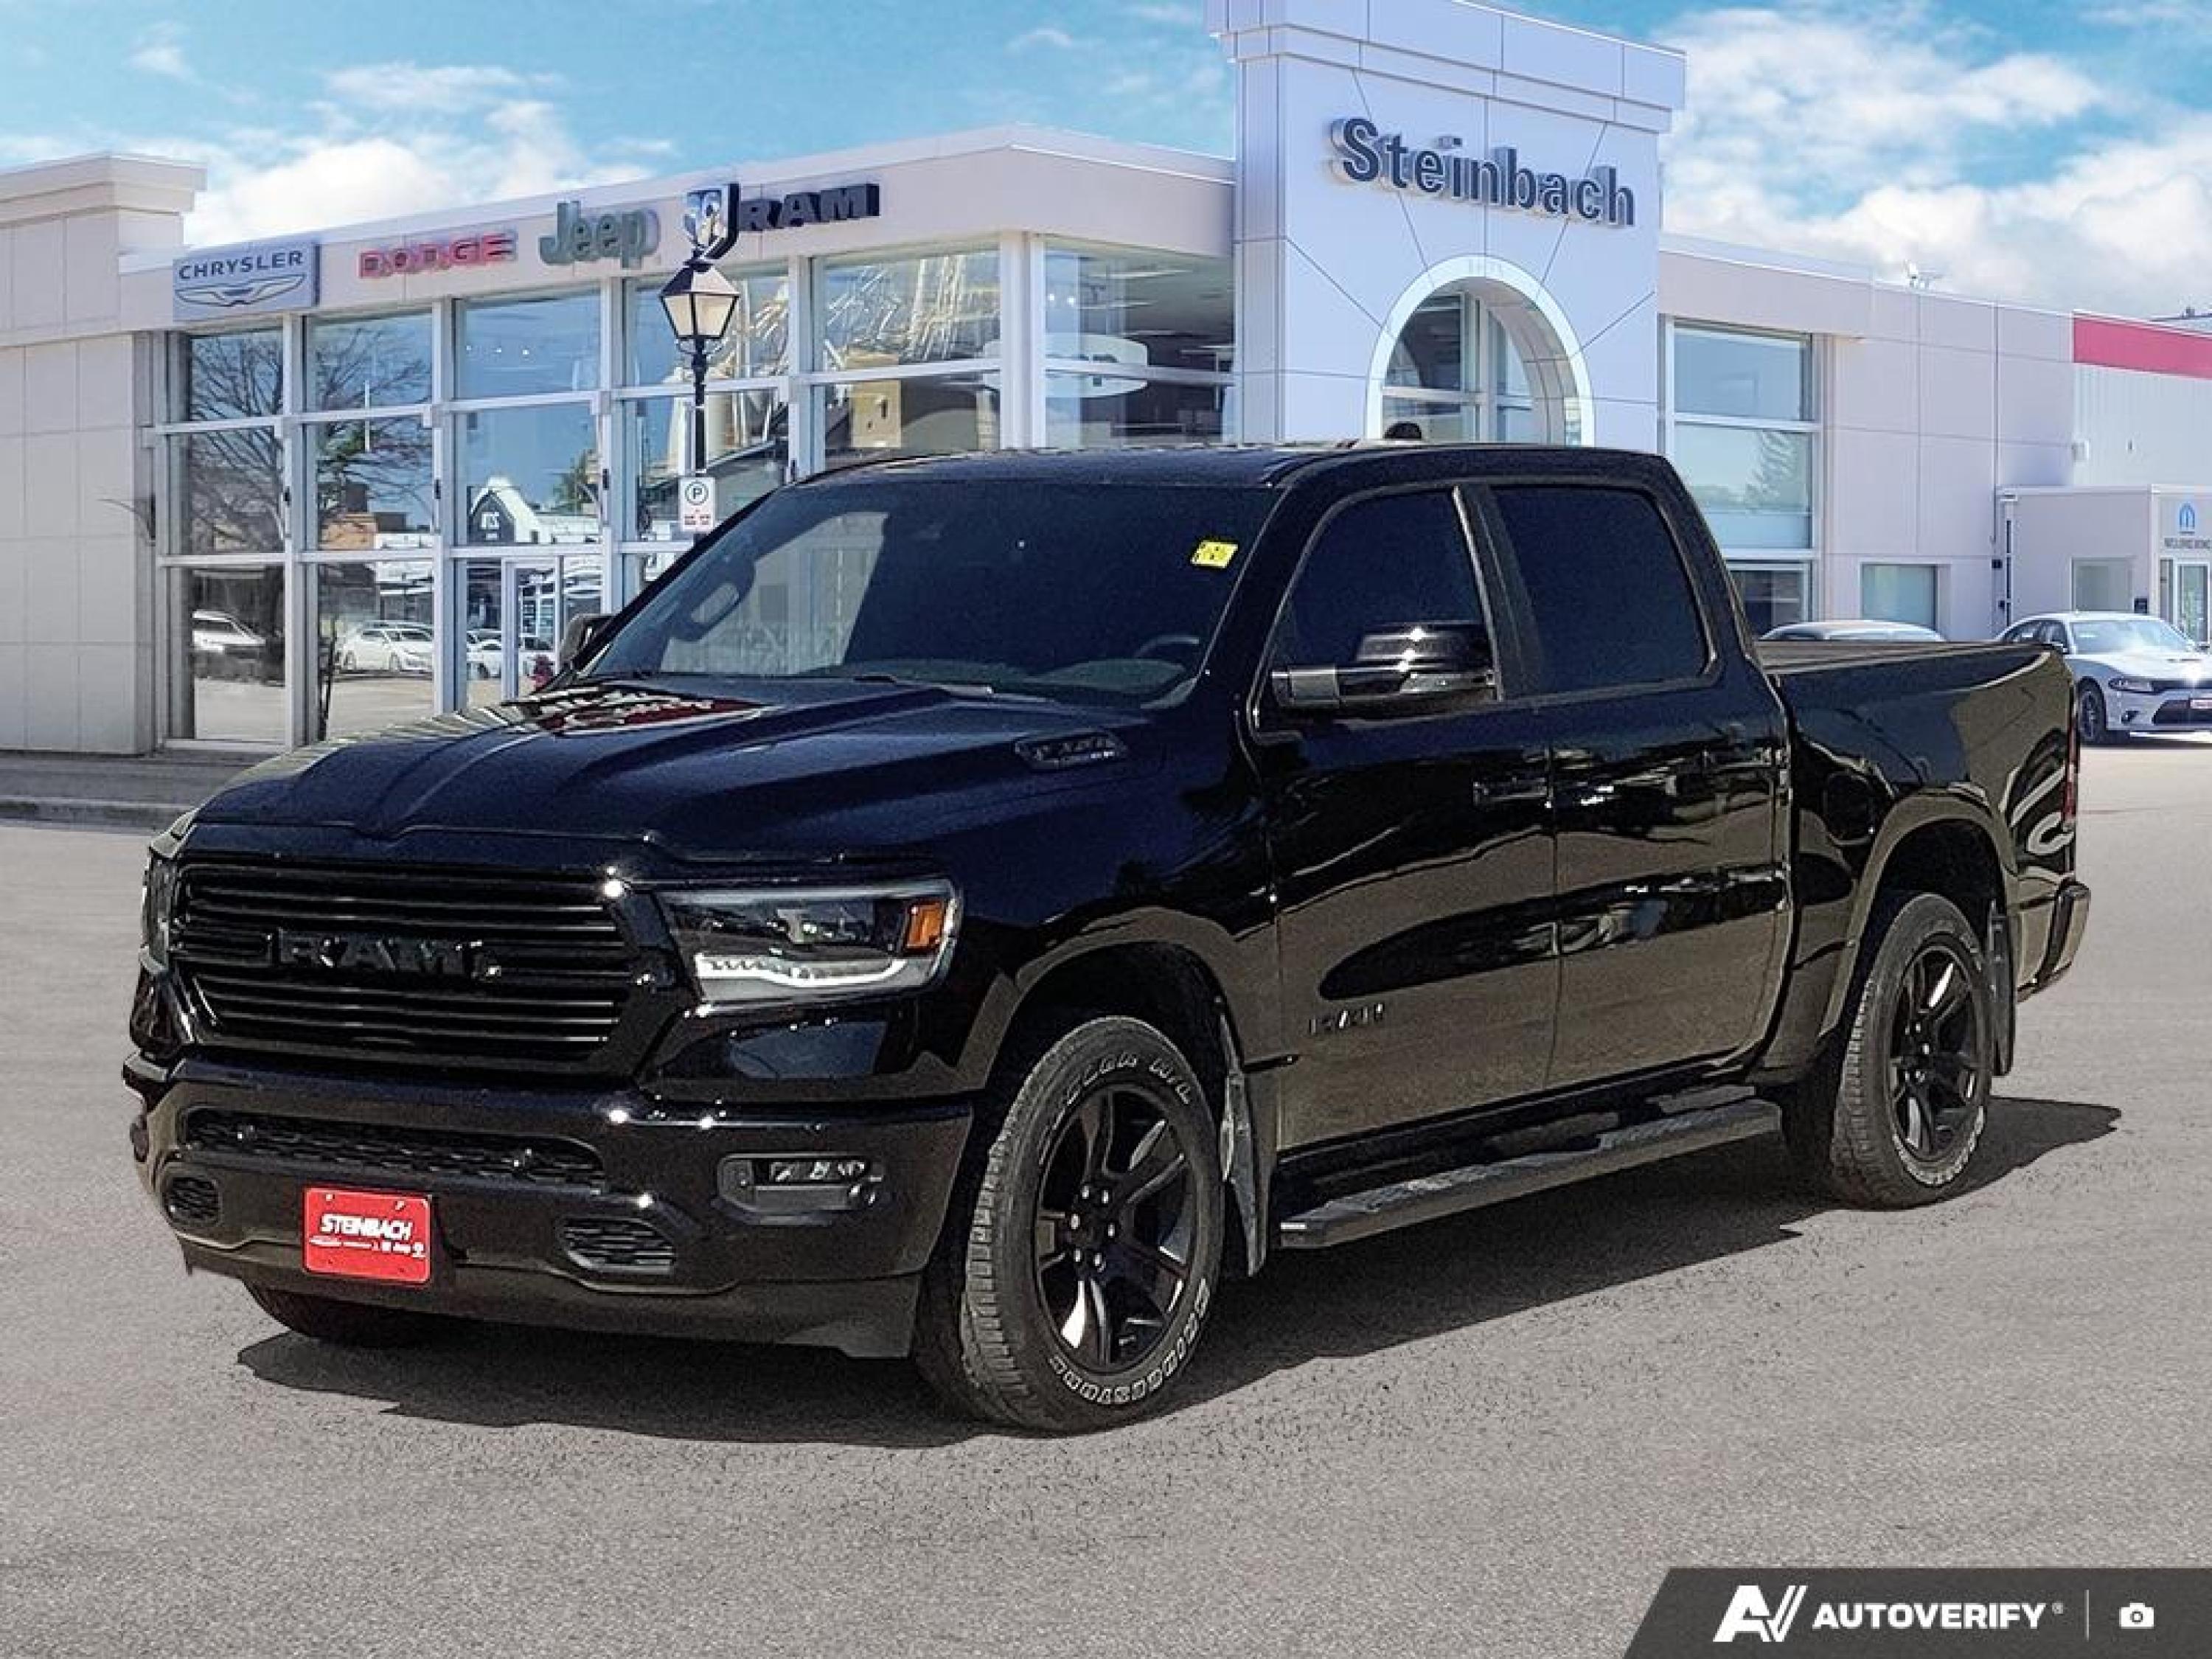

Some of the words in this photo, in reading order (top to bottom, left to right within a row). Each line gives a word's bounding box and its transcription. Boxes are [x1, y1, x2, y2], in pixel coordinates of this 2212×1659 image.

[1333, 116, 1635, 226] Steinbach
[740, 183, 880, 232] RAM
[358, 229, 516, 278] DODGE
[538, 199, 660, 268] Jeep
[178, 249, 304, 280] CHRYSLER
[319, 1213, 414, 1241] STEINBACH
